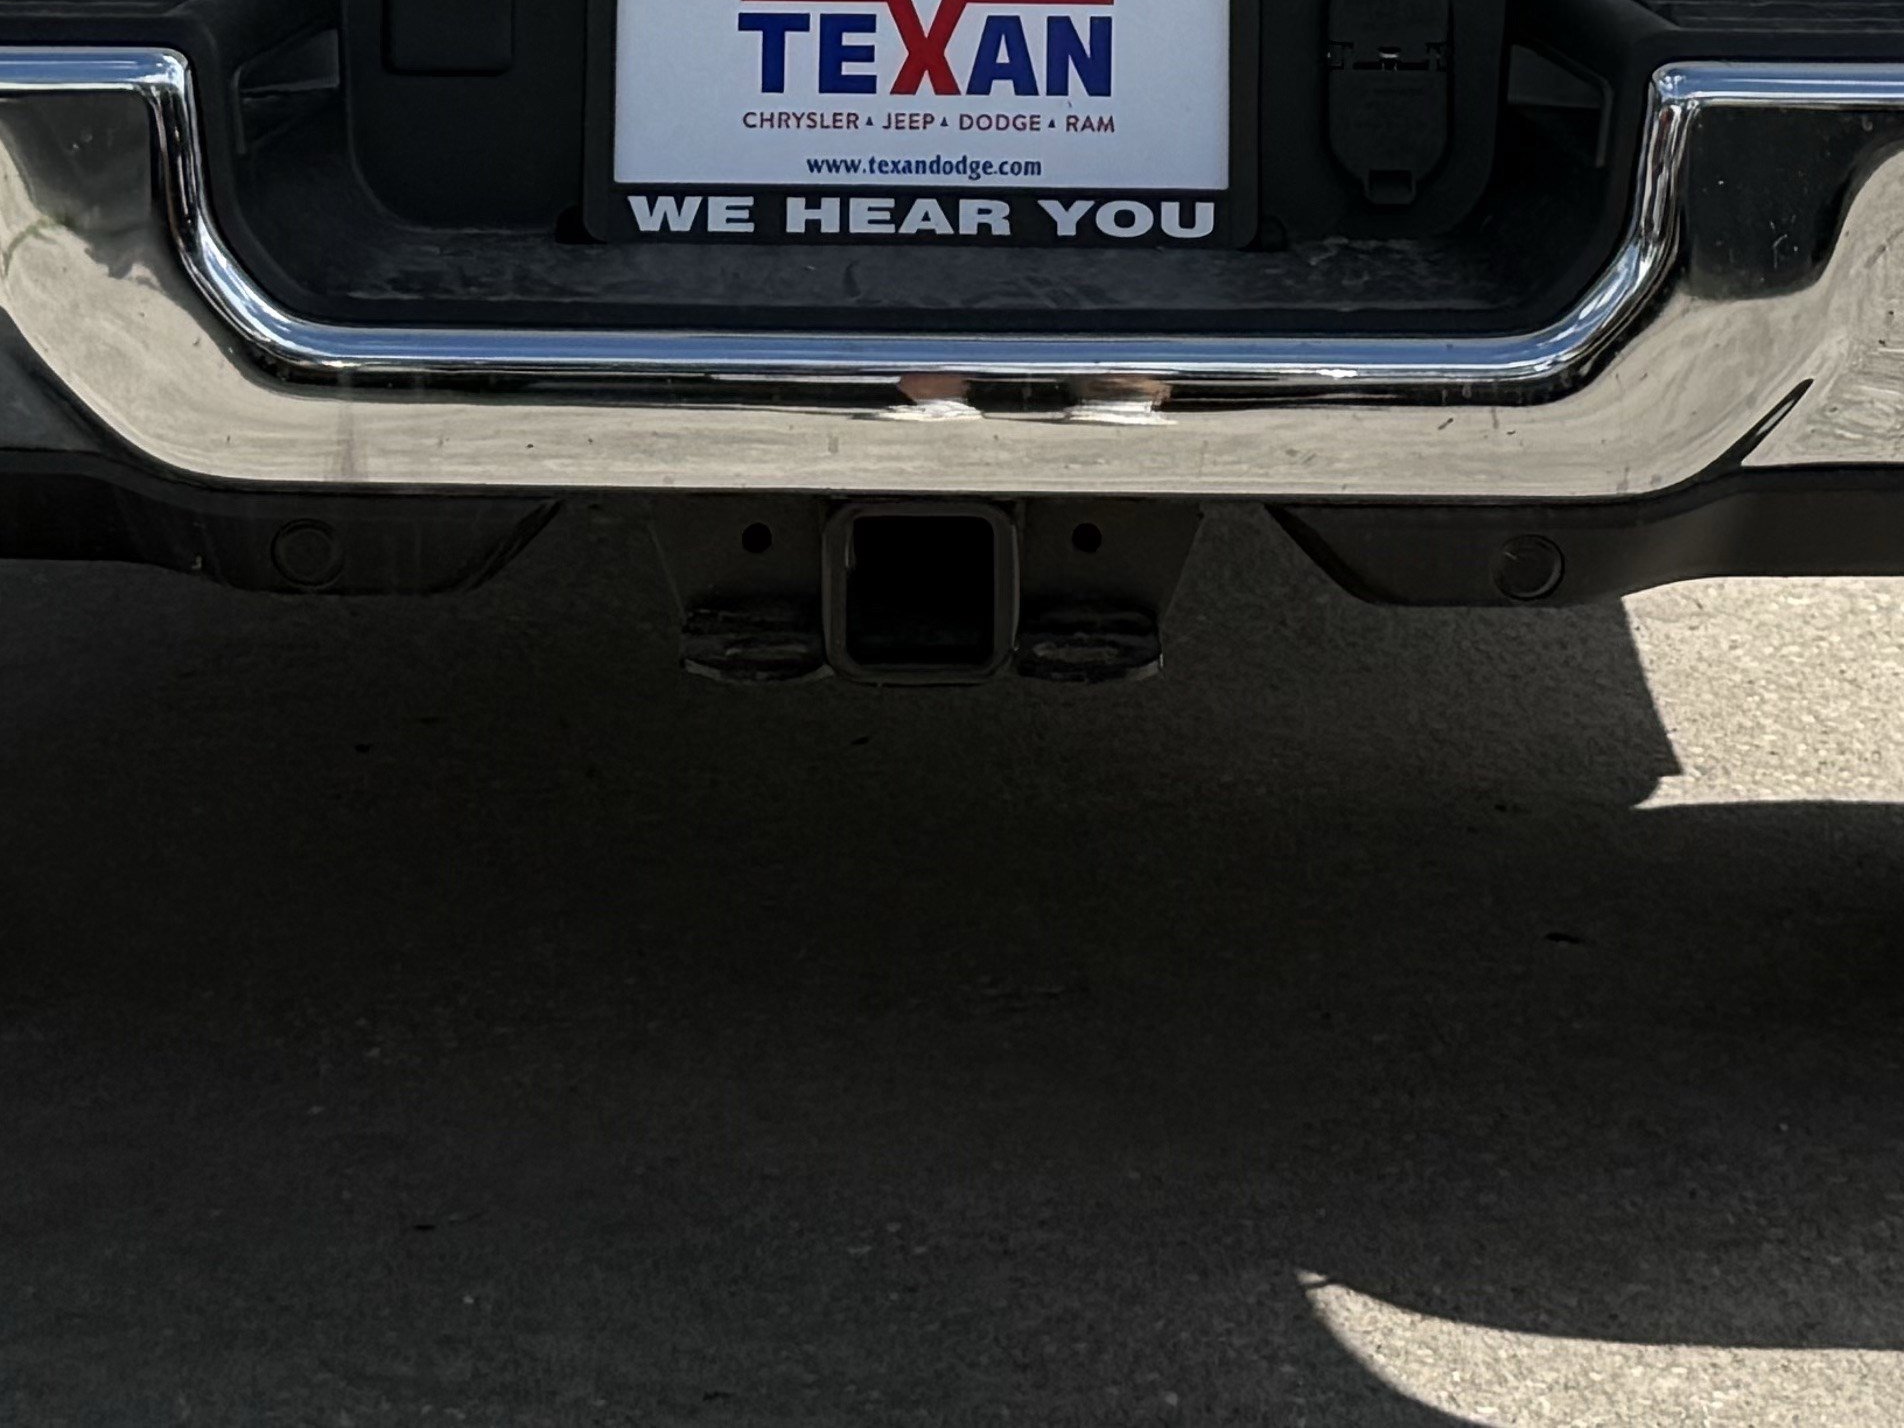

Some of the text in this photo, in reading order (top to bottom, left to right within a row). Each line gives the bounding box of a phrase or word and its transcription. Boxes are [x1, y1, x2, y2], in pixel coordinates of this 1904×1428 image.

[742, 110, 1116, 133] CHRYSLER JEEP DODGE RAM
[806, 154, 1042, 181] www.texandodge.com
[626, 195, 1216, 239] WE HEAR YOU
